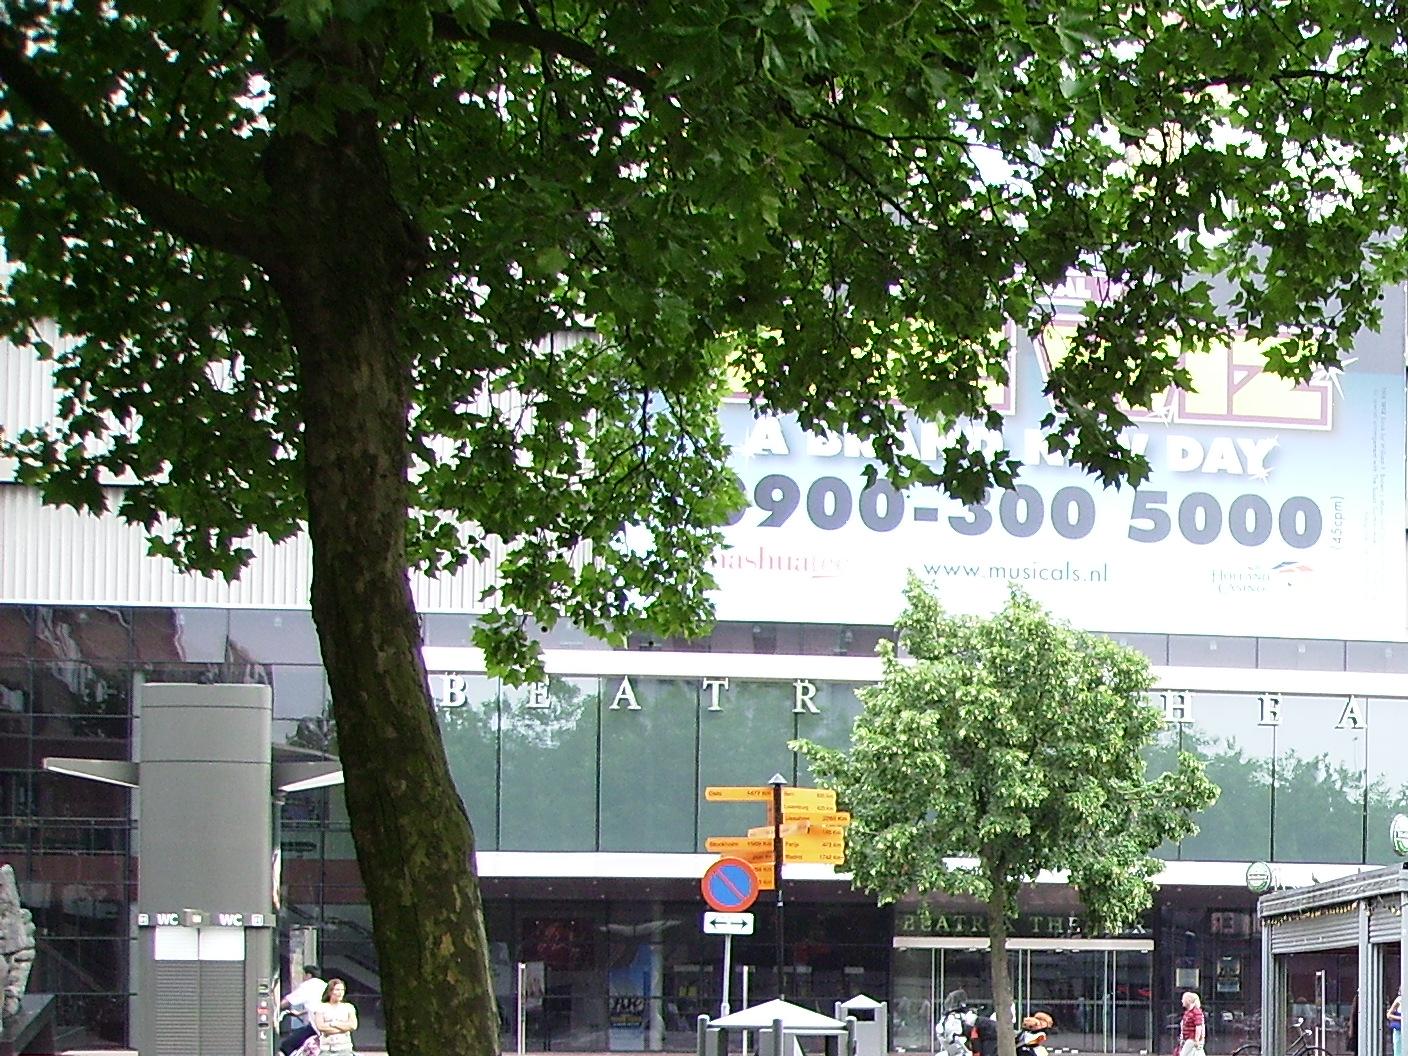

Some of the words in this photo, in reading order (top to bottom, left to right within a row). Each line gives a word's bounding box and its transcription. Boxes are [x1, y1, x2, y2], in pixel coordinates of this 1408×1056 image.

[752, 416, 790, 455] A
[1167, 434, 1277, 476] DAY
[1127, 490, 1323, 549] 5000
[923, 561, 1107, 582] www.musicals.nl
[157, 913, 179, 925] WC
[219, 913, 243, 926] WC
